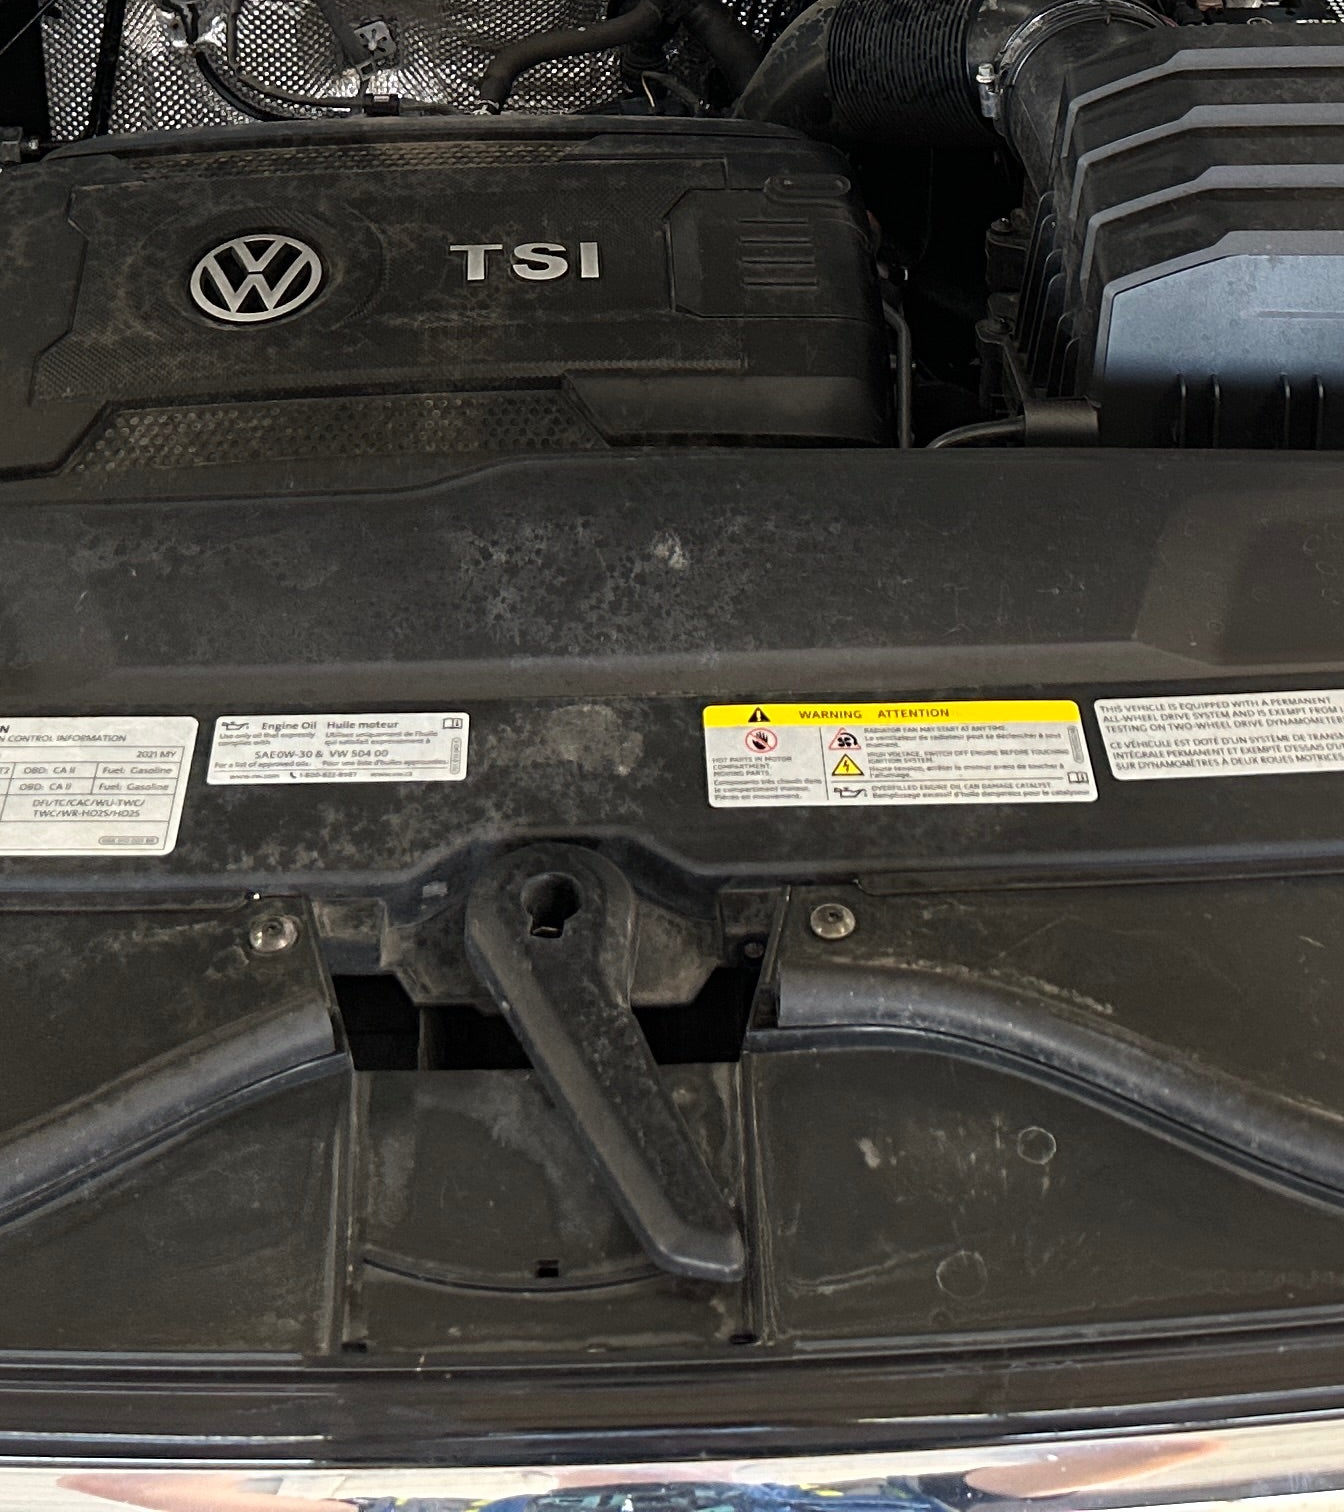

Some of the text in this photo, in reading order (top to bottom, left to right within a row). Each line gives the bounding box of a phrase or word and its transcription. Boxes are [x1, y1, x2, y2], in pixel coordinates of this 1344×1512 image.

[450, 242, 601, 281] TSI
[1100, 705, 1123, 713] THIS
[1123, 704, 1166, 712] VEHICLE
[1179, 701, 1230, 710] EQUIPPED
[1231, 699, 1259, 708] WITH
[1261, 699, 1268, 707] A
[1270, 696, 1331, 706] PERMANENT
[799, 708, 949, 719] WARNING ATTENTION
[1103, 713, 1158, 722] ALL-WHEEL
[1160, 712, 1191, 721] DRIVE
[1192, 710, 1230, 720] SYSTEM
[1232, 708, 1255, 717] AND
[1257, 708, 1267, 717] IS
[1268, 707, 1306, 716] EXEMPT
[1309, 705, 1338, 714] FROM
[262, 721, 399, 731] Engine Oil Huile moteur
[1106, 724, 1148, 733] TESTING
[1149, 723, 1166, 732] ON
[1167, 721, 1232, 731] TWO-WHEEL
[1234, 718, 1264, 728] DRIVE
[8, 735, 53, 743] CONTROL
[56, 734, 127, 742] INFORMATION
[1109, 741, 1123, 749] CE
[1174, 739, 1191, 747] EST
[1293, 734, 1306, 742] DE
[137, 750, 157, 759] 2021
[160, 750, 177, 758] MY
[315, 750, 324, 758] &
[329, 750, 349, 758] VW
[351, 749, 372, 757] 504
[374, 749, 389, 757] 00
[1166, 748, 1226, 758] PERMANENT
[1227, 747, 1239, 755] ET
[1115, 762, 1136, 771] SUR
[1231, 755, 1259, 765] DEUX
[1261, 754, 1295, 764] ROUES
[130, 767, 173, 775] Gasoline
[49, 783, 63, 791] CA
[127, 783, 169, 791] Gasoline
